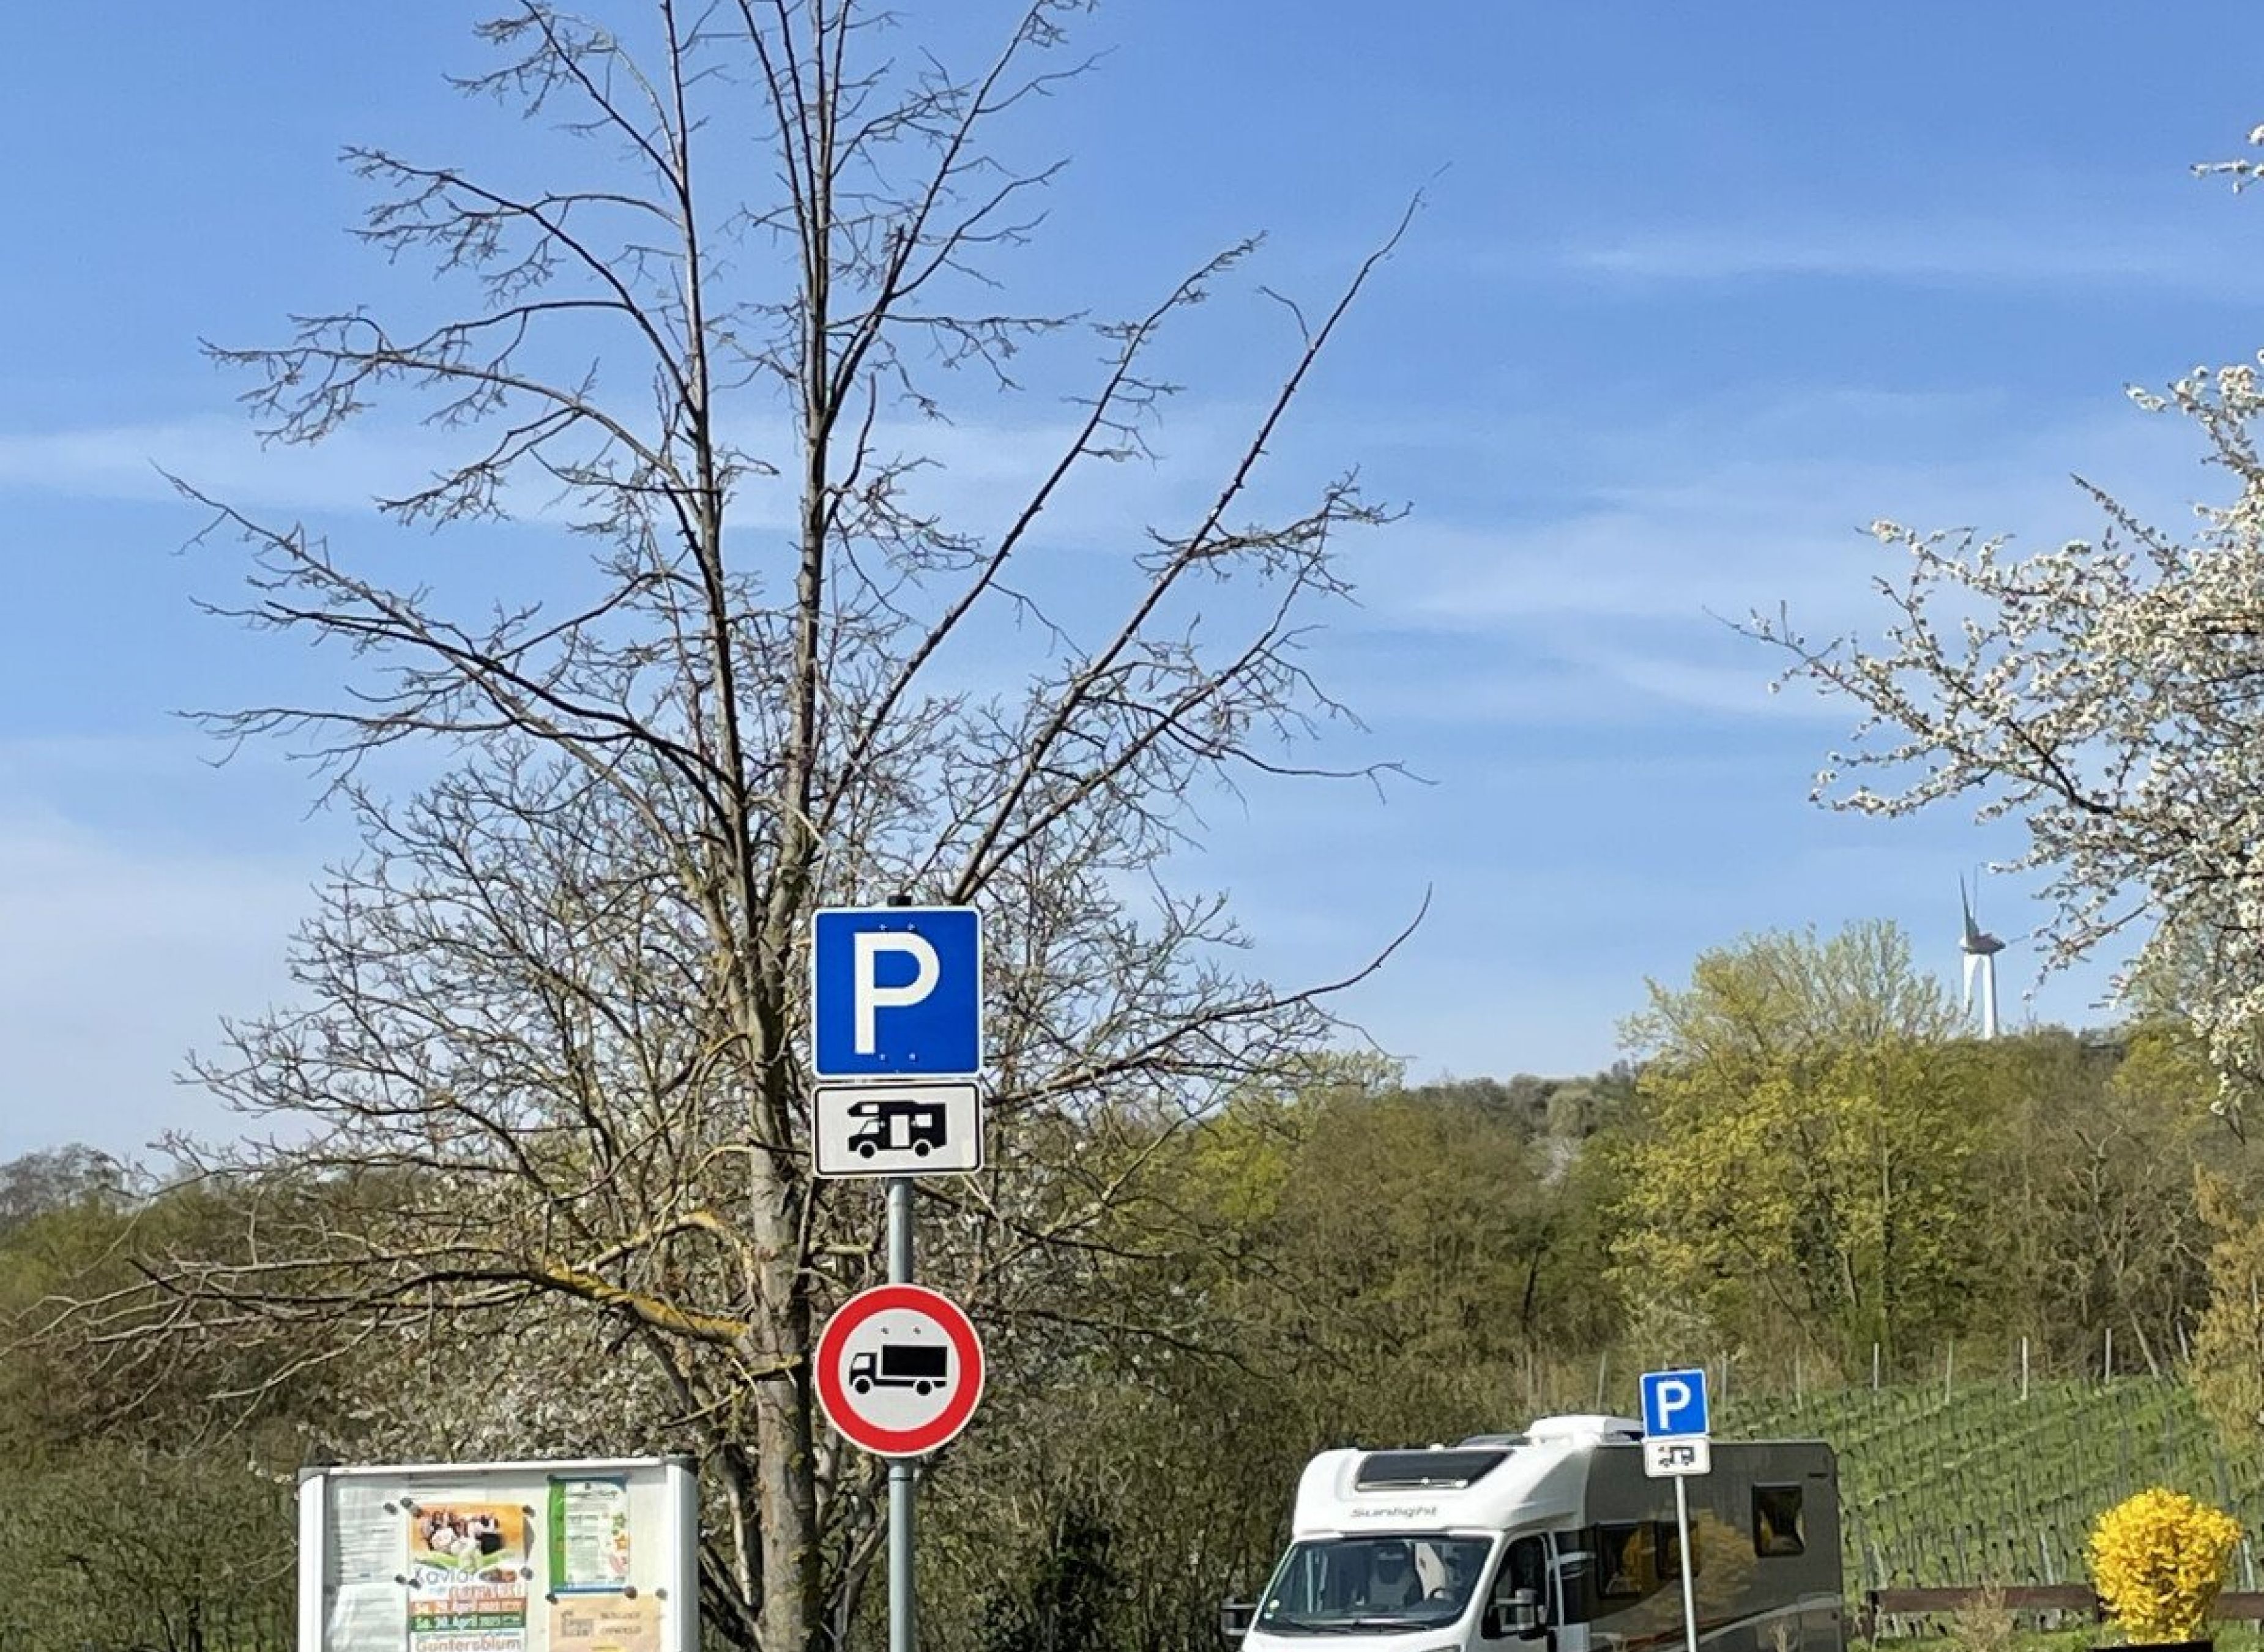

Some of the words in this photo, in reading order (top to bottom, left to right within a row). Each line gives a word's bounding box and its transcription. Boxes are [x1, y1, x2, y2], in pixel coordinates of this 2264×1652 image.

[854, 932, 940, 1054] P
[1656, 1380, 1691, 1431] P
[1351, 1505, 1437, 1519] Sunlight
[416, 1635, 521, 1652] Guntersblum
